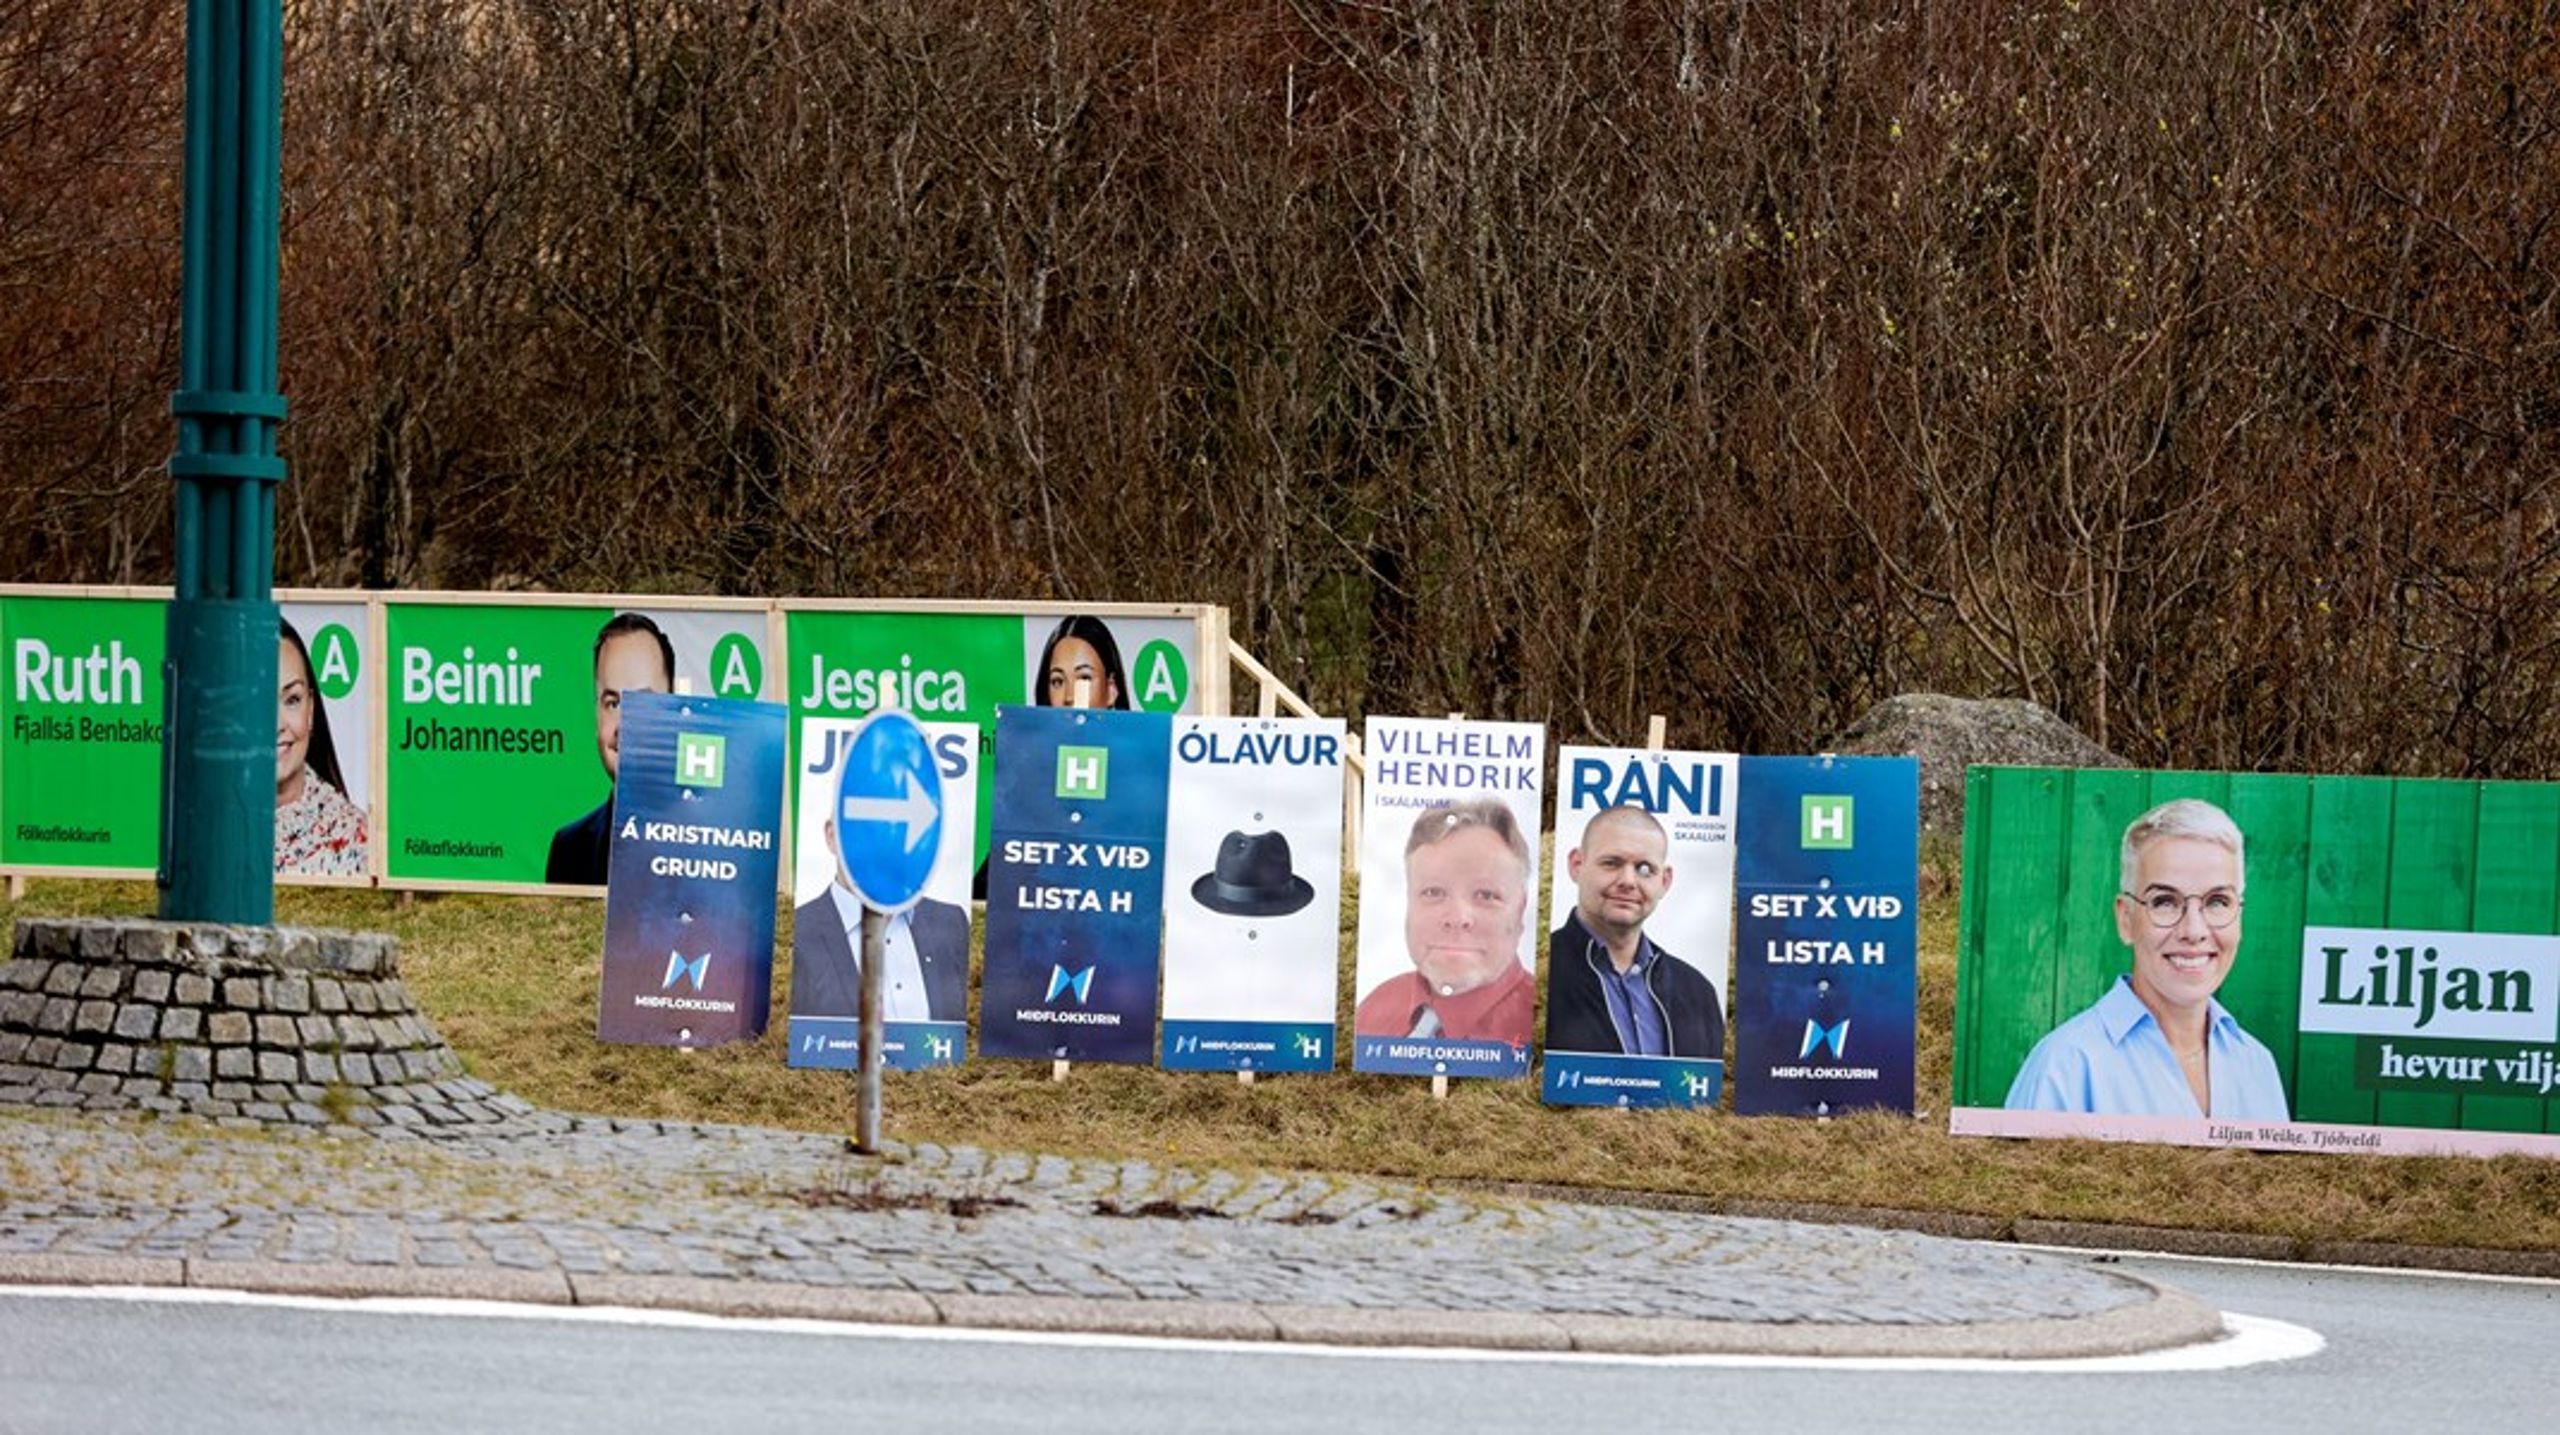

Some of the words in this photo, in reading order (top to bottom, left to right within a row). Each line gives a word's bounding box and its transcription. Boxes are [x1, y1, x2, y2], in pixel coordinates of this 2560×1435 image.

[15, 638, 142, 704] Ruth
[320, 634, 351, 684] A
[721, 644, 753, 694] A
[403, 646, 542, 706] Beinir
[1144, 651, 1178, 703] A
[14, 714, 74, 745] Fjallsá
[400, 716, 564, 754] Johannesen
[1178, 723, 1338, 766] ÓLAVUR
[1378, 729, 1532, 759] VILHELM
[685, 744, 716, 779] H
[1066, 757, 1098, 790] H
[1377, 760, 1535, 790] HENDRIK
[621, 816, 639, 840] Á
[645, 822, 771, 849] KRISTNARI
[1811, 806, 1843, 840] H
[651, 857, 737, 880] GRUND
[1004, 840, 1060, 864] SET
[1066, 843, 1088, 867] X
[1095, 845, 1150, 869] VIÐ
[1018, 886, 1102, 912] LISTA
[1110, 890, 1132, 913] H
[1751, 894, 1808, 917] SET
[1815, 895, 1838, 918] X
[1844, 896, 1902, 919] VIÐ
[1767, 941, 1854, 963] LISTA
[1862, 942, 1884, 964] H
[2318, 945, 2534, 1029] Liljan
[2380, 1045, 2488, 1081] hevur
[2208, 1126, 2253, 1144] Liljan
